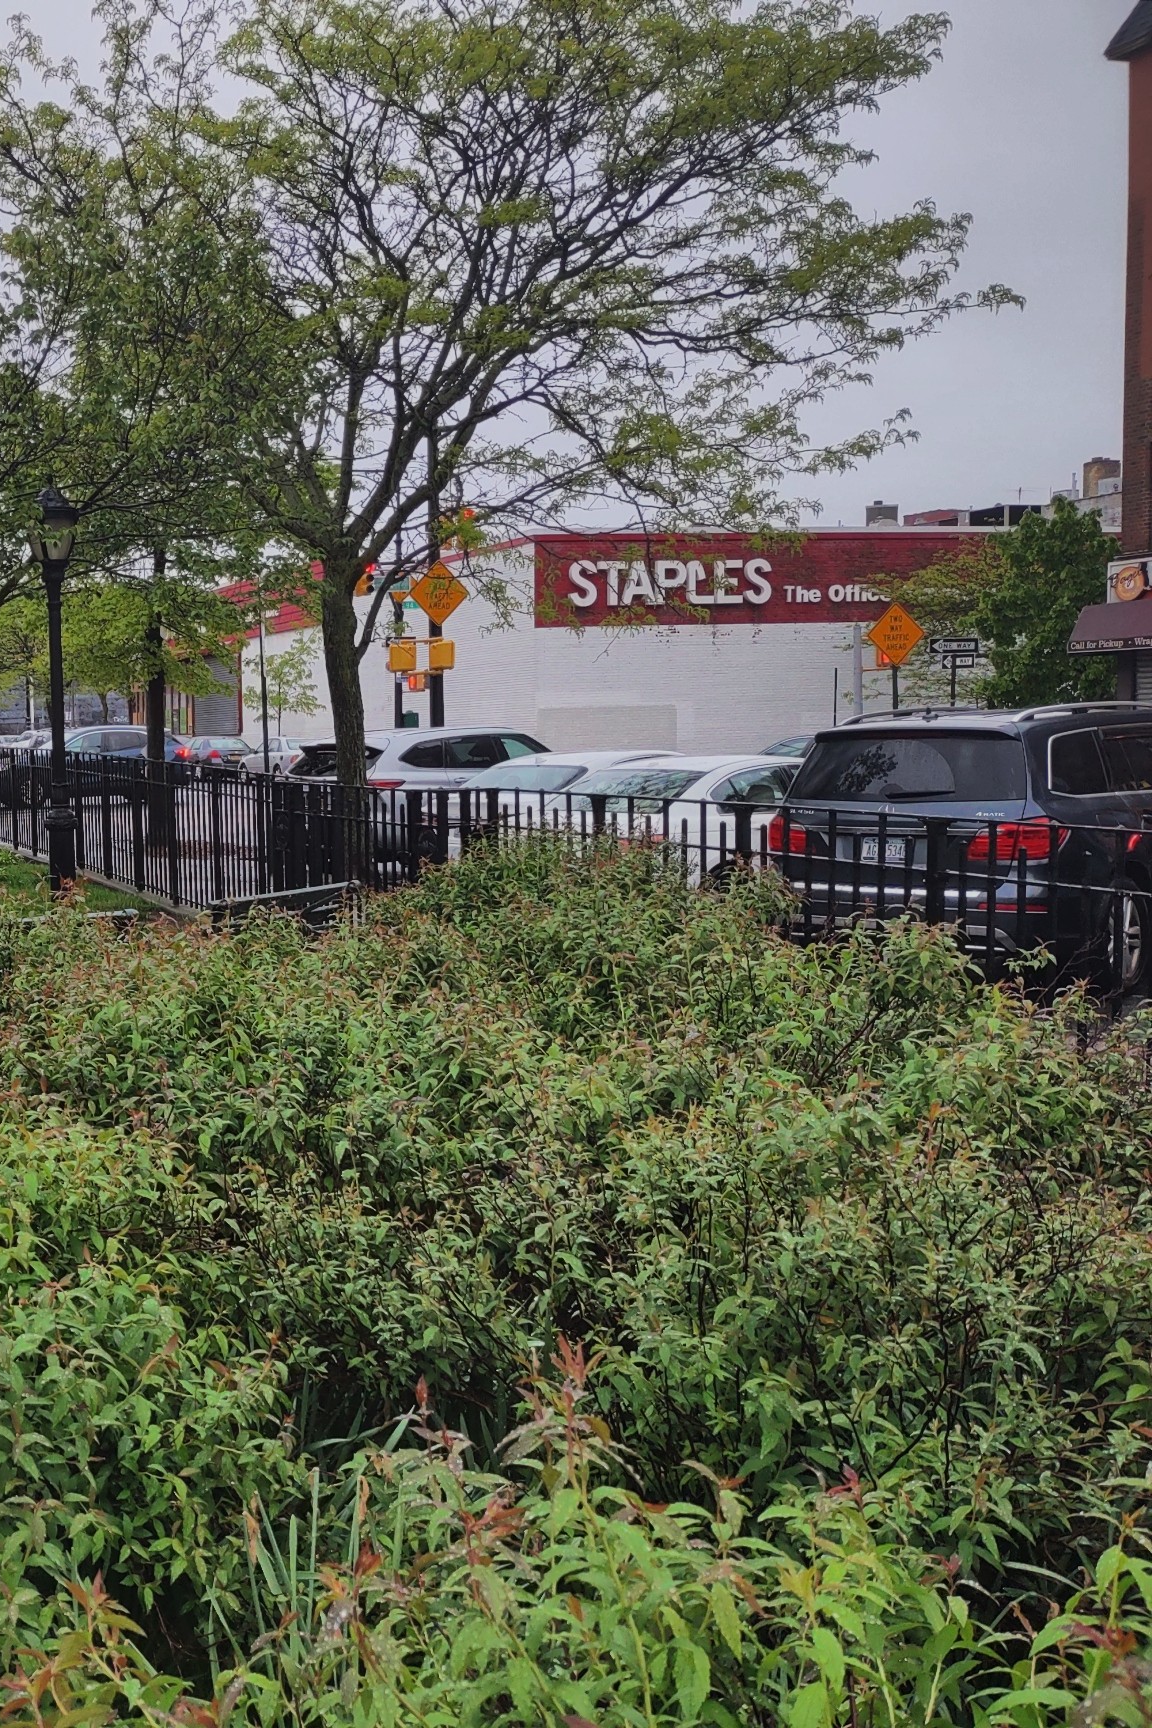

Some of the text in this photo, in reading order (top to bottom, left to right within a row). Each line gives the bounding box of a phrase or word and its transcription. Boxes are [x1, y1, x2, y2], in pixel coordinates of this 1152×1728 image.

[567, 558, 773, 607] STAPLES
[783, 585, 822, 603] The
[1070, 642, 1085, 650] Call
[1086, 641, 1097, 649] for
[1098, 640, 1124, 648] Pickup
